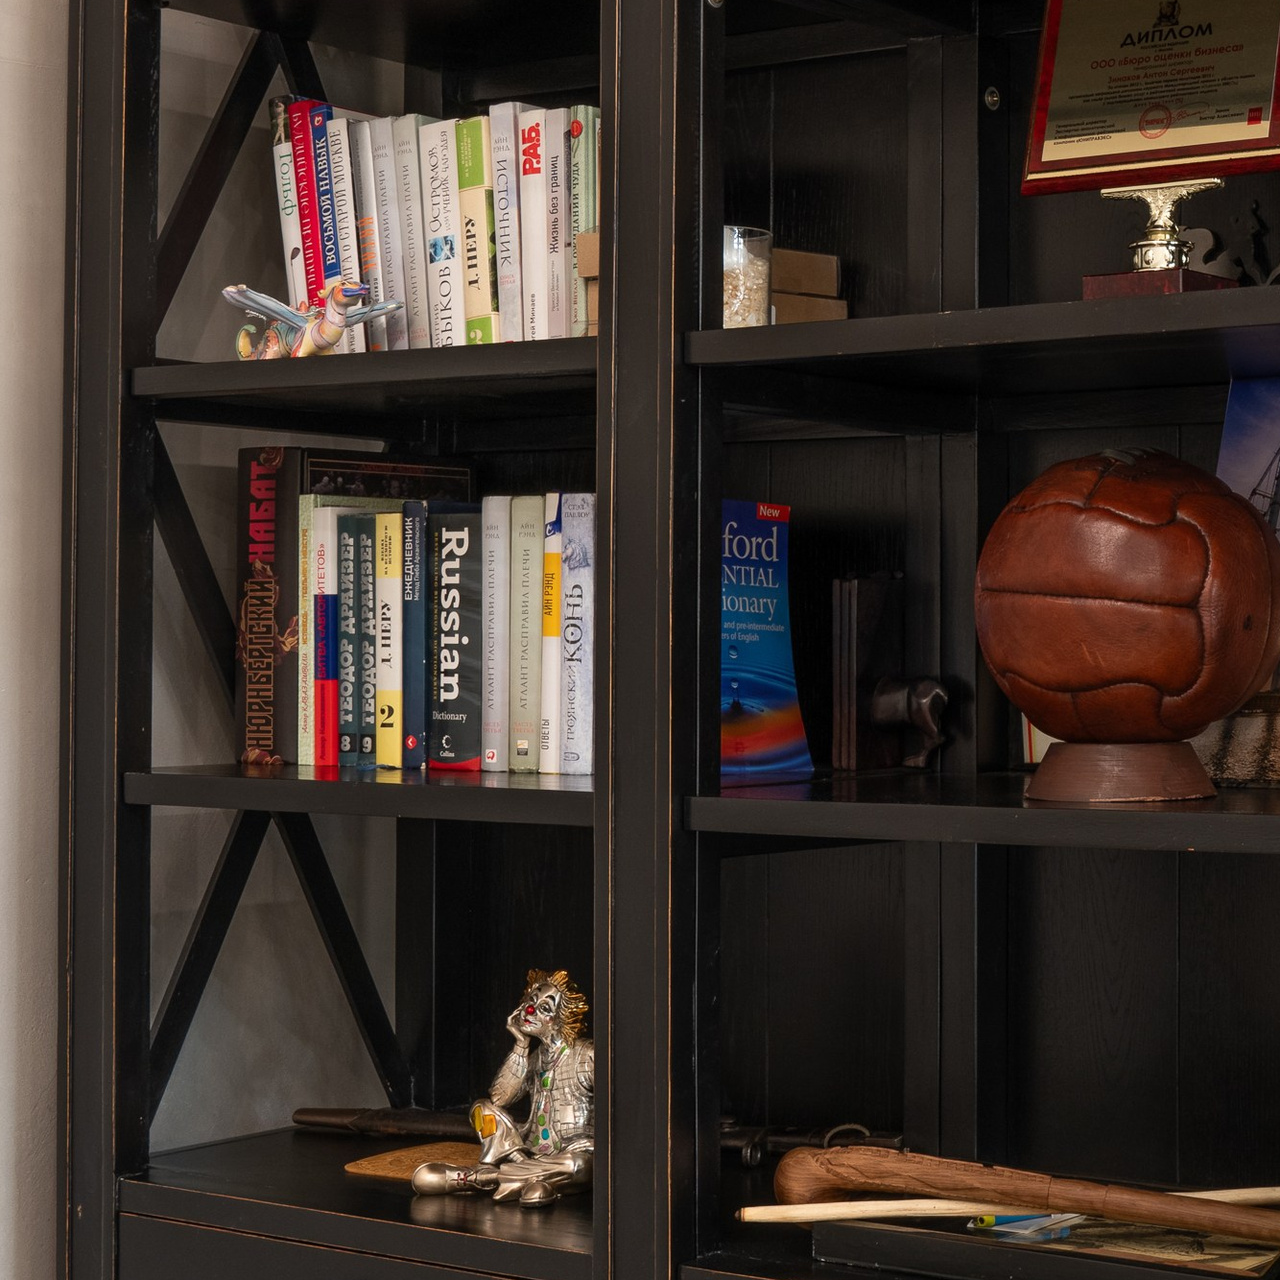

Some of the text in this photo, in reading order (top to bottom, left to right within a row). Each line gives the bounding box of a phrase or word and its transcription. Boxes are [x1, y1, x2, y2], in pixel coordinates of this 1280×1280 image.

[1091, 44, 1244, 70] ООО «Бюро оценки бизнеса»
[1120, 23, 1213, 49] ДИПЛОМ
[279, 153, 295, 216] Гольф
[521, 122, 541, 176] Р.А.Б.
[315, 136, 337, 264] ВОСЬМОЙ НАВЫК
[330, 132, 349, 242] СТАРОЙ МОСКВЕ
[497, 159, 511, 266] ИСТОЧНИК
[549, 155, 560, 253] Жизнь без границ
[465, 219, 478, 286] Д. НЕРУ
[439, 266, 452, 346] БЫКОВ
[249, 459, 276, 564] НАБАТ
[759, 505, 780, 518] New
[404, 518, 414, 600] ЕЖЕДНЕВНИК
[339, 532, 355, 723] ТЕОДОР ДРАЙЗЕР
[359, 533, 376, 725] ТЕОДОР ДРАЙЗЕР
[380, 603, 392, 667] Д. НЕРУ
[440, 527, 469, 702] Russian
[564, 584, 583, 662] КОНЬ
[737, 632, 759, 642] English
[246, 577, 274, 749] НЮРНБЕРГСКИЙ
[340, 735, 351, 752] 8
[362, 735, 372, 753] 9
[380, 704, 394, 728] 2
[433, 711, 467, 723] Dictionary
